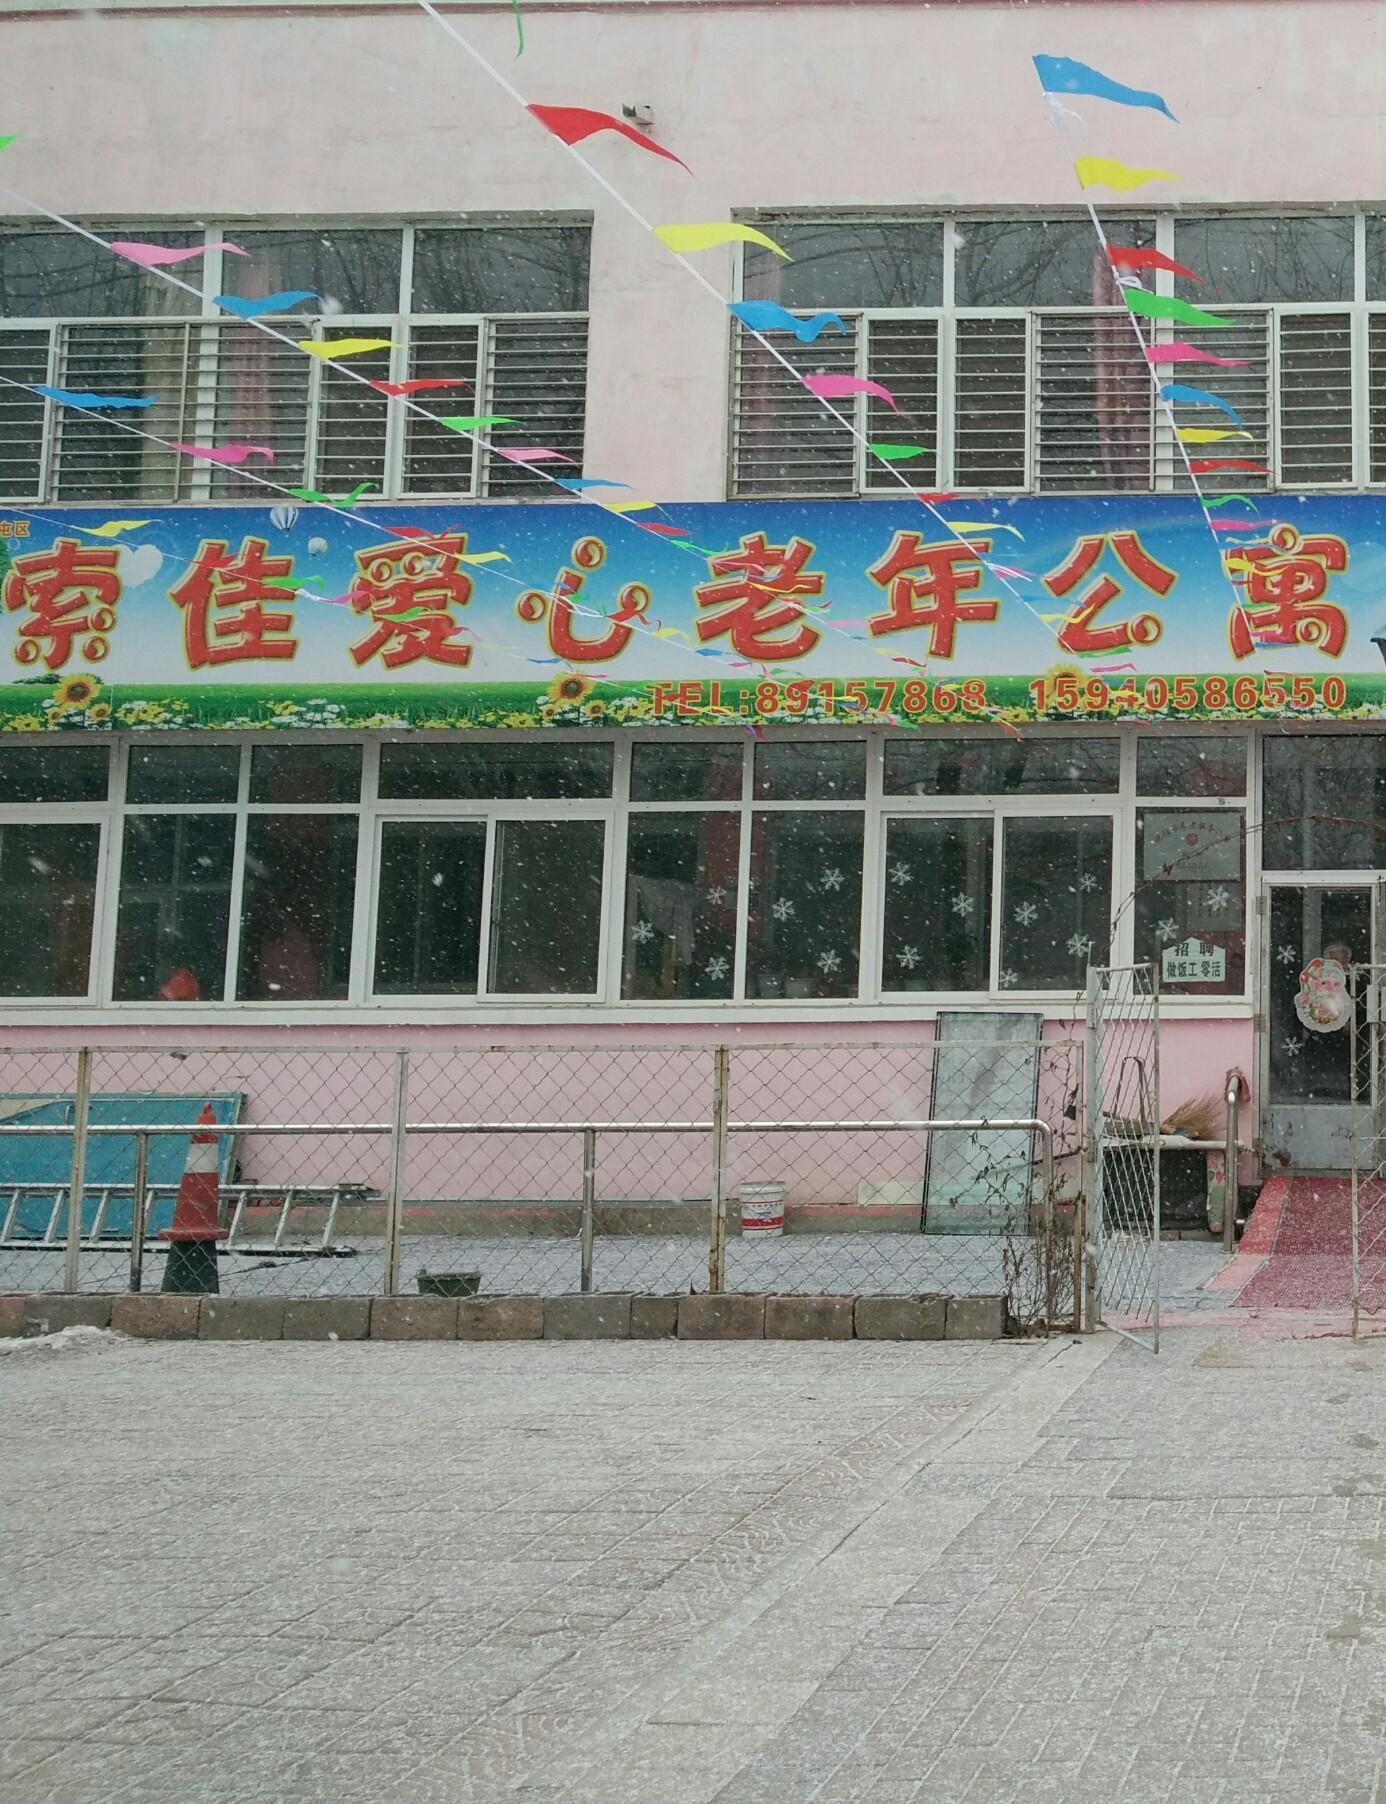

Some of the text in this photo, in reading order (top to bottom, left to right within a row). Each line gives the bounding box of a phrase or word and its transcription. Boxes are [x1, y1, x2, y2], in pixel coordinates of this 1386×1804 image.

[2, 525, 1349, 671] 索佳爱心老年公寓
[1174, 942, 1214, 957] 招聘
